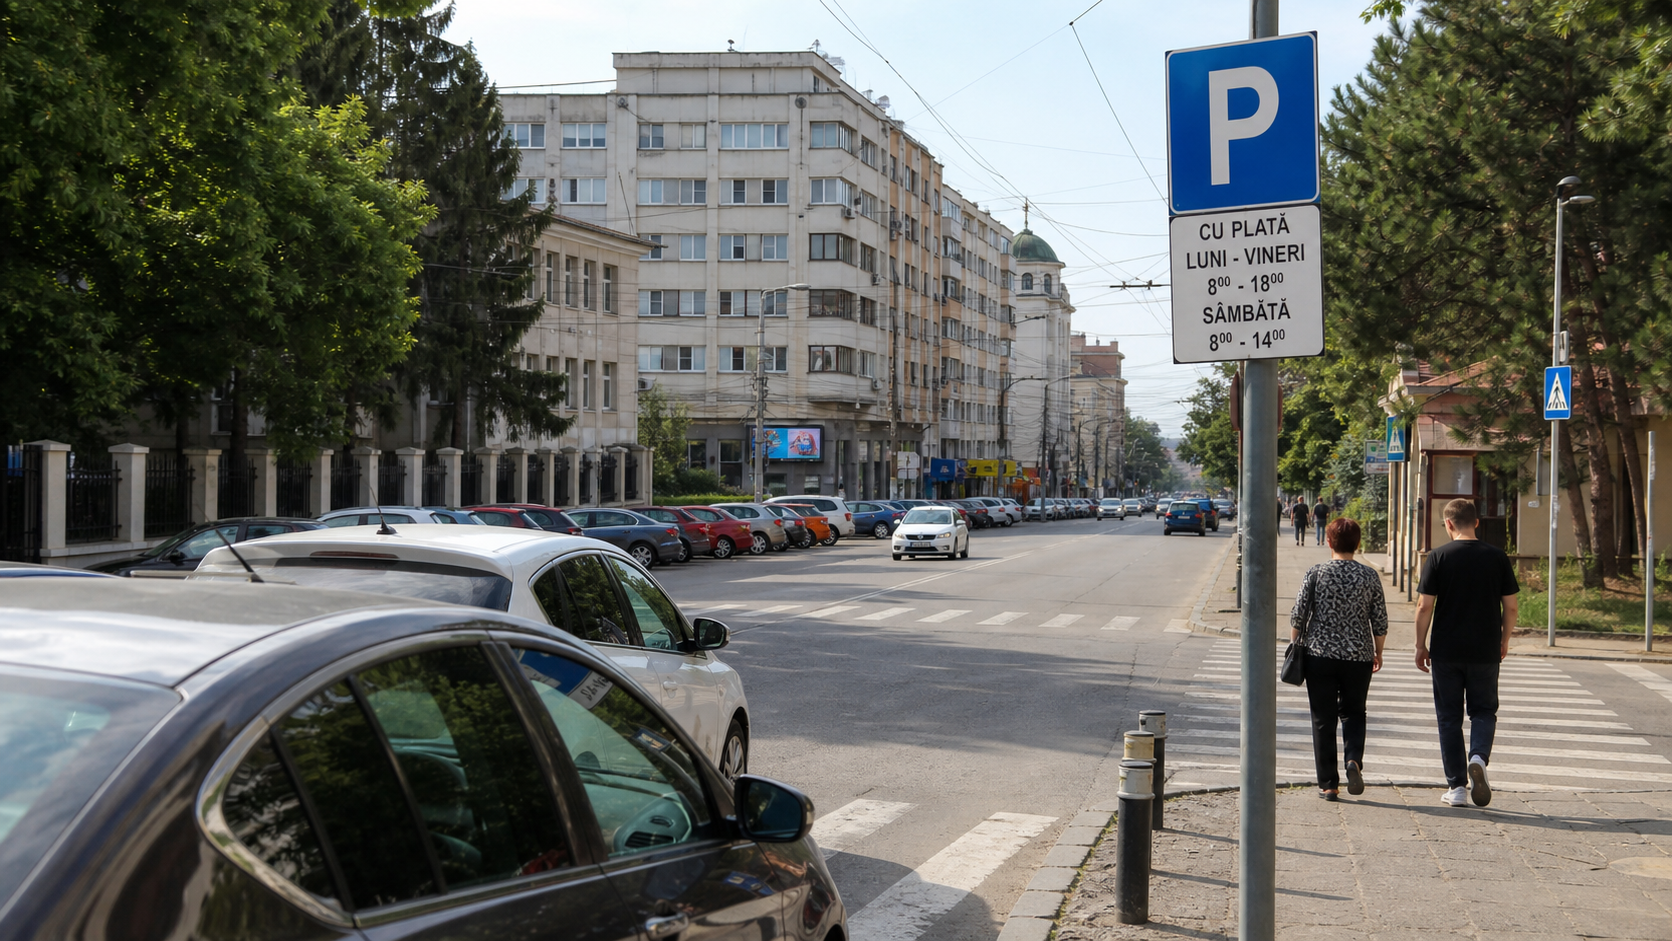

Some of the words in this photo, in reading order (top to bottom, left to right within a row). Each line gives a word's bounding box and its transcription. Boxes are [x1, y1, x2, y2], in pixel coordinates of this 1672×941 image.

[1208, 66, 1280, 186] P
[1199, 222, 1224, 241] CU
[1232, 212, 1290, 239] PLATĂ
[1186, 250, 1227, 270] LUNI
[1244, 243, 1305, 266] VINERI
[1202, 297, 1291, 325] SÂMBĂTĂ
